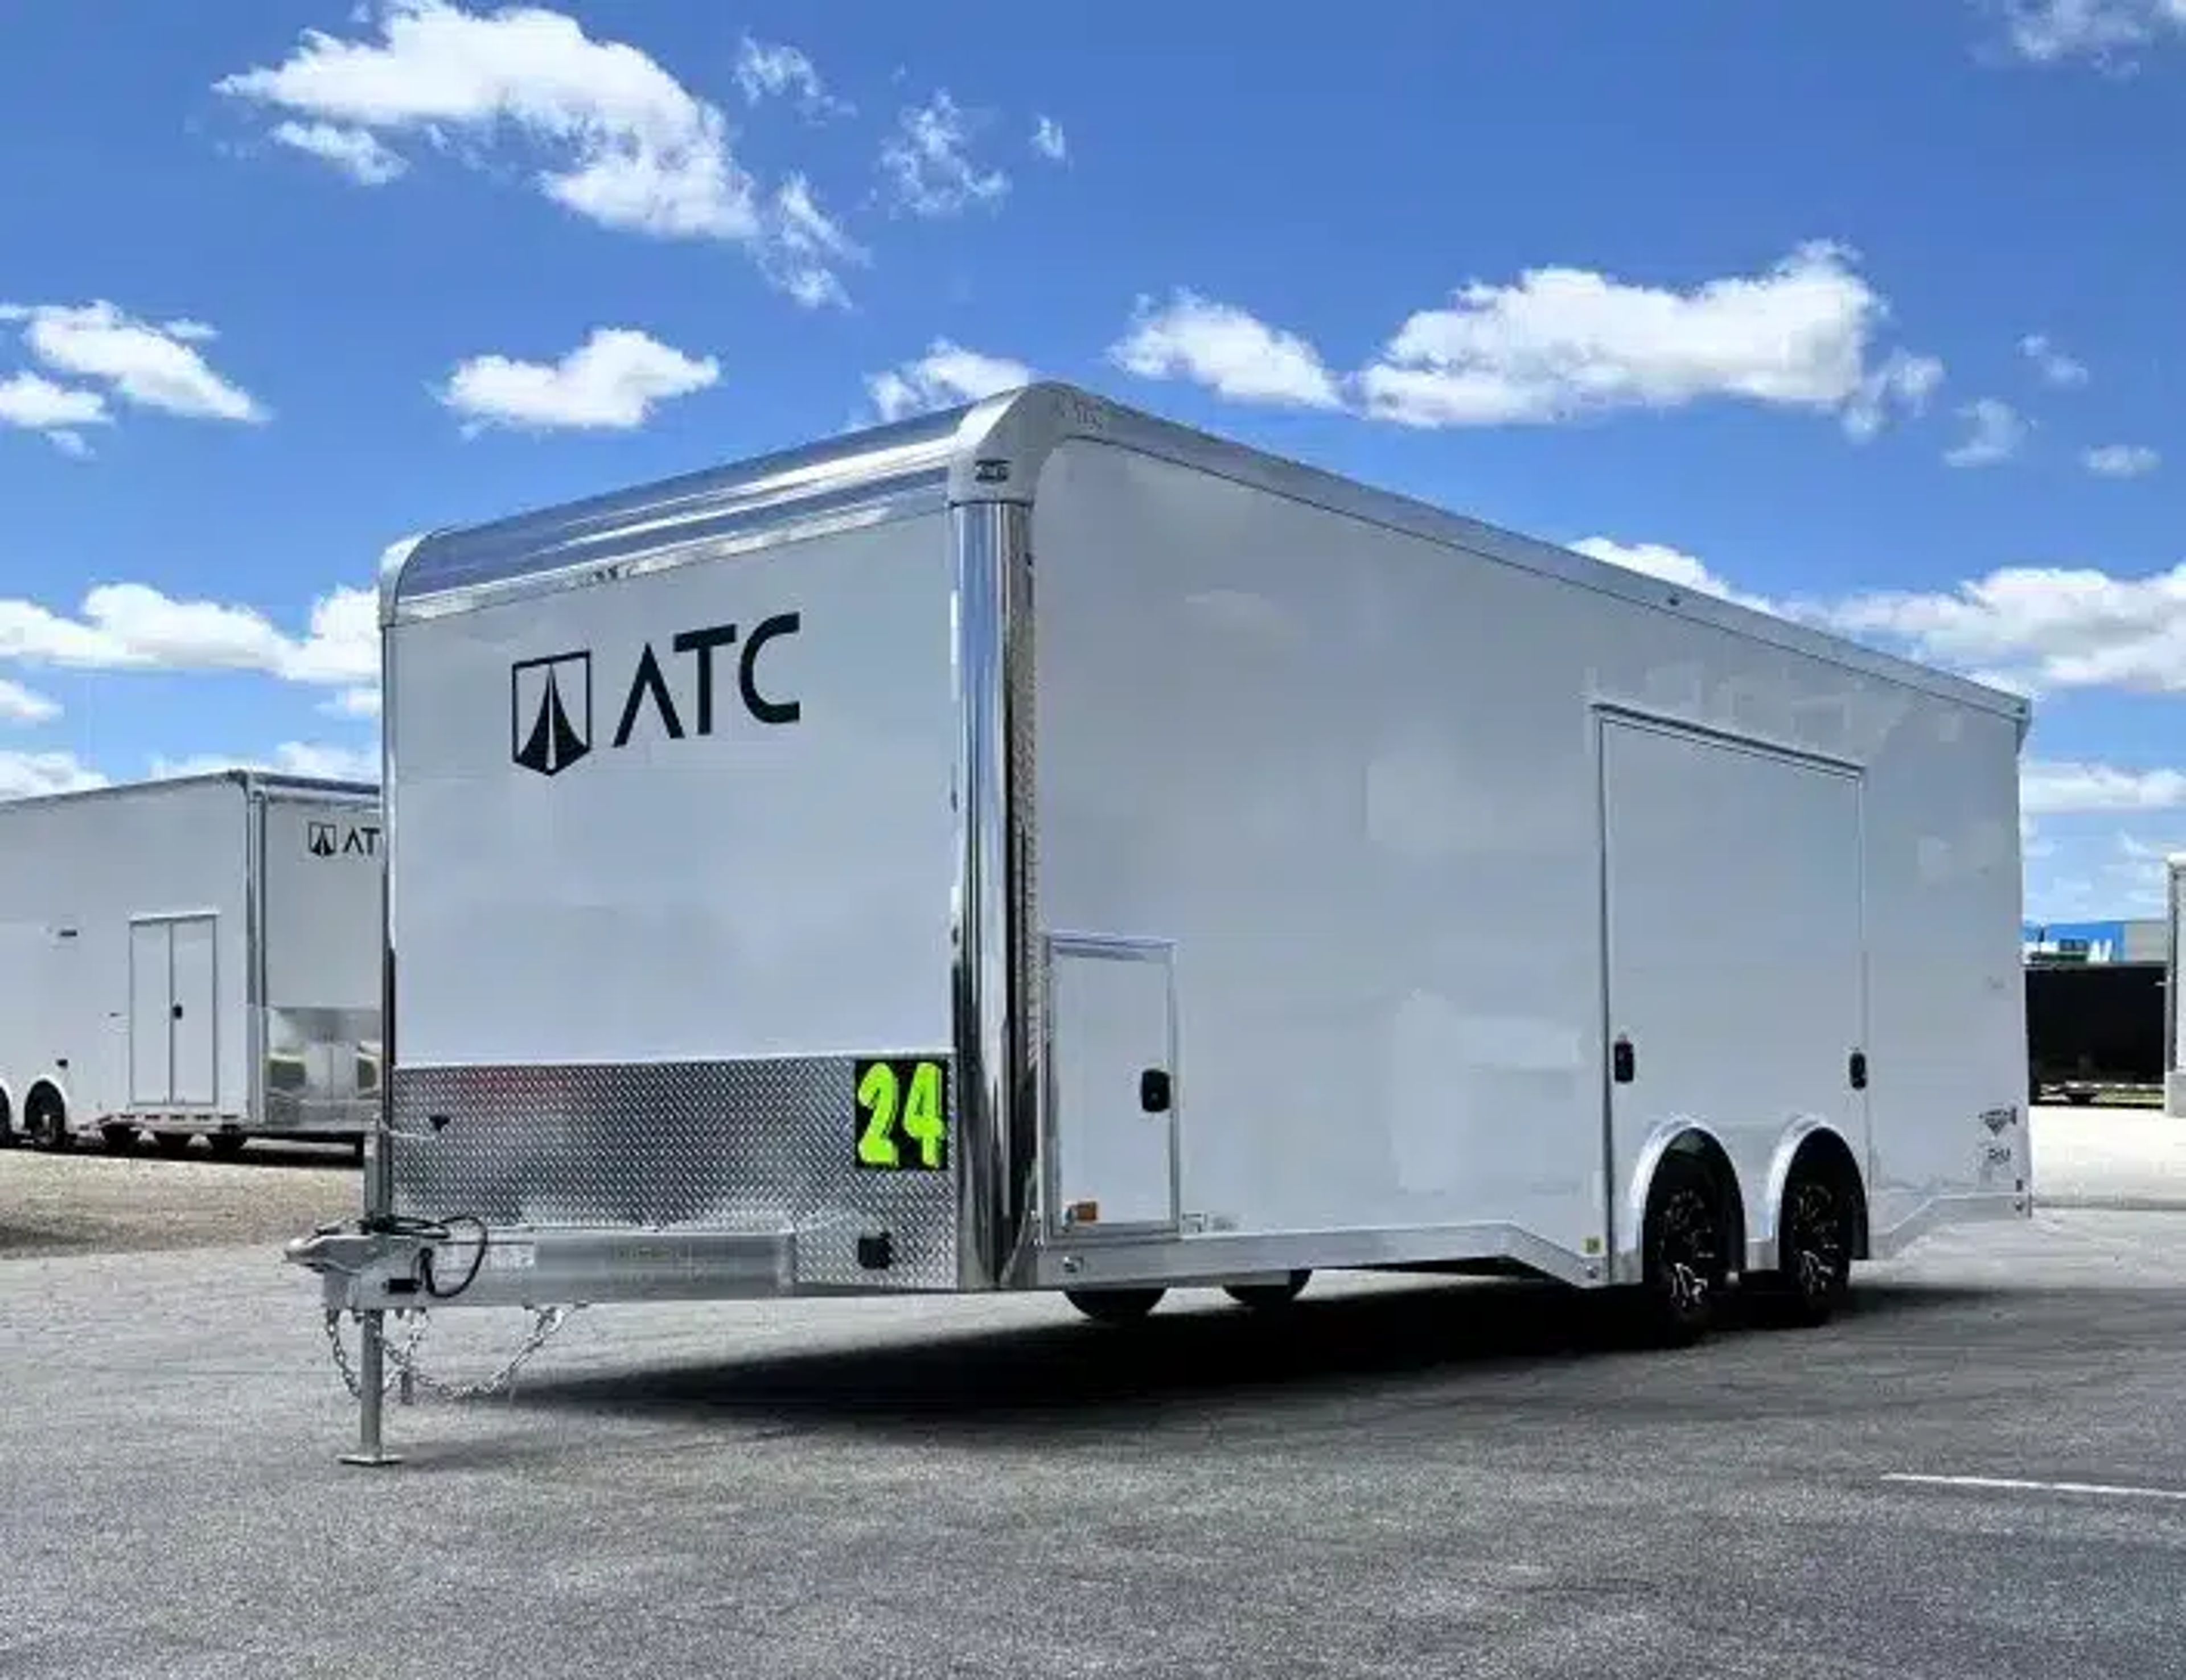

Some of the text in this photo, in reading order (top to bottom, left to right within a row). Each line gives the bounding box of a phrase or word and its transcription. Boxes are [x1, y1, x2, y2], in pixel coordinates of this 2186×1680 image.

[613, 612, 800, 747] ATC
[342, 827, 383, 856] AT
[858, 1062, 946, 1168] 24
